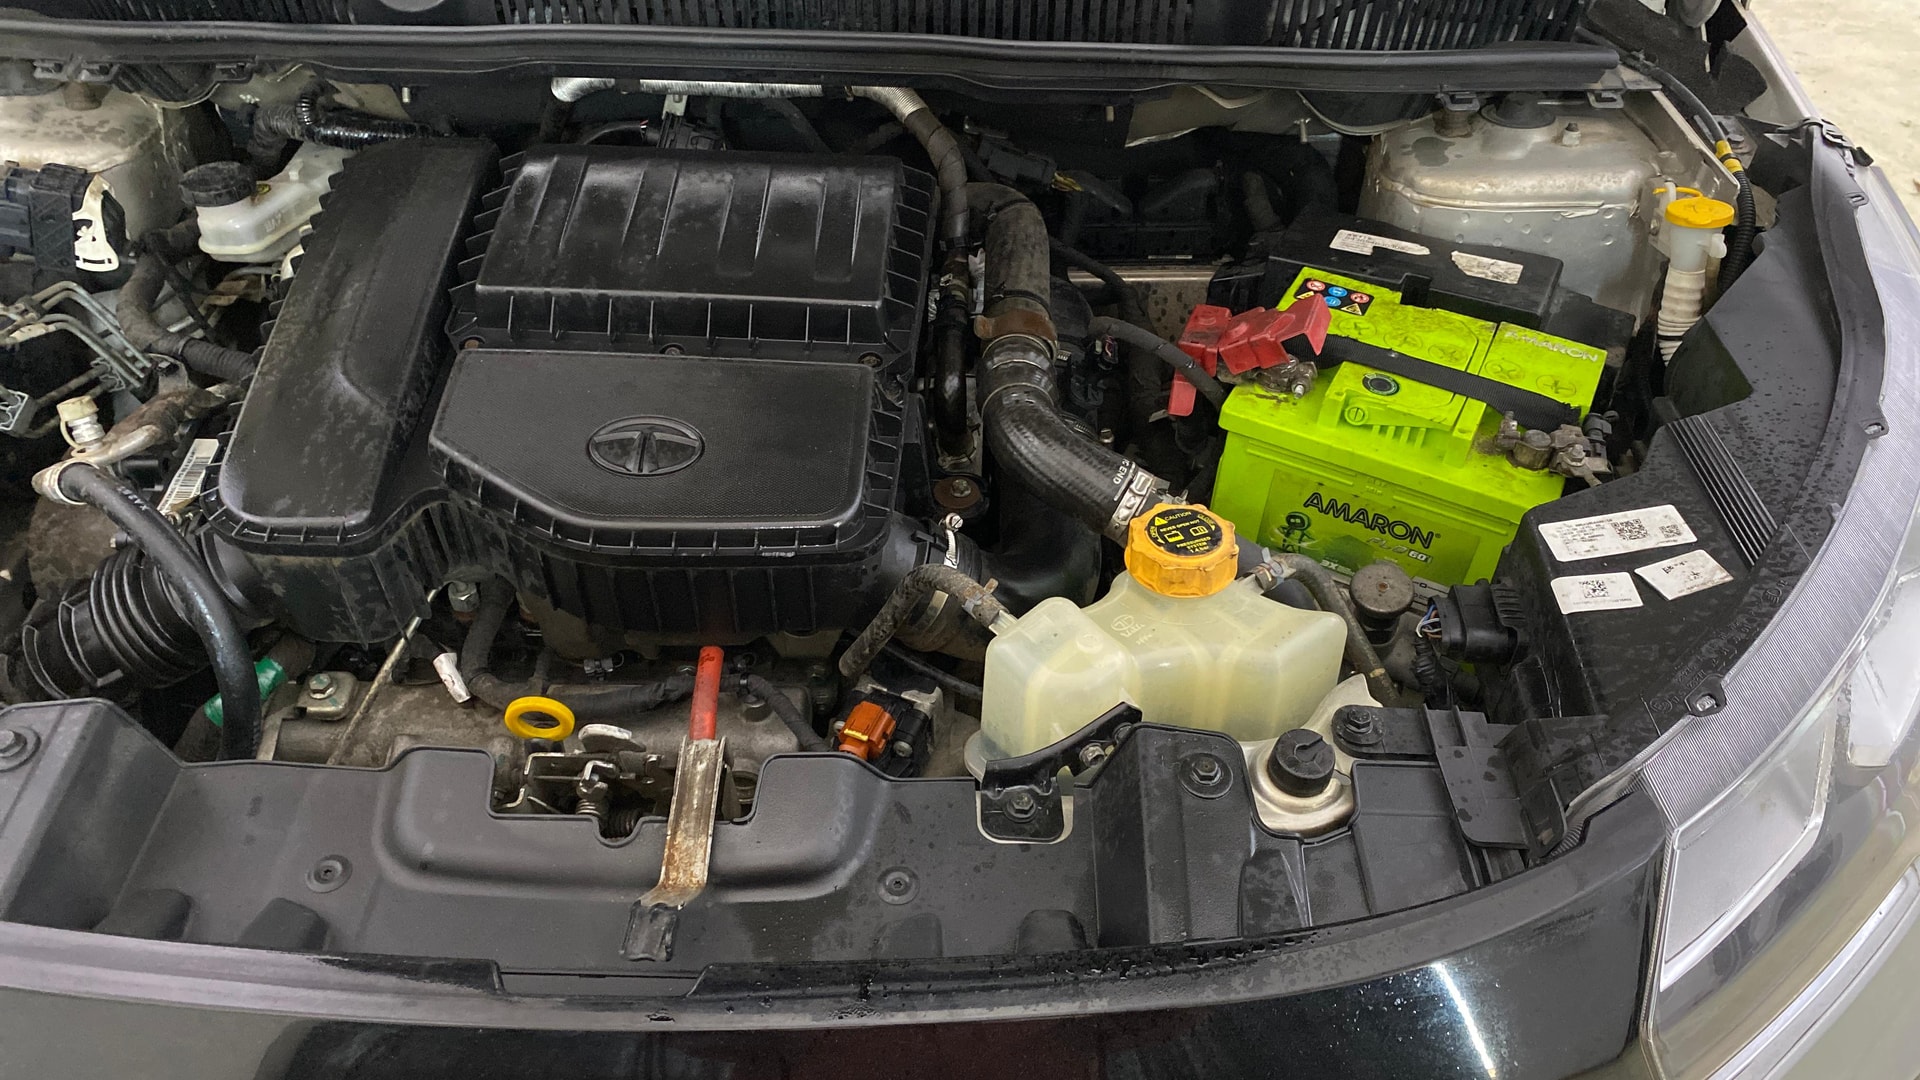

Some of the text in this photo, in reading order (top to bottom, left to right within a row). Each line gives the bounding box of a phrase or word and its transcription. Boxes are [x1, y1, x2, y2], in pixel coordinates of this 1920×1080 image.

[1504, 331, 1598, 362] AMARON
[1113, 466, 1127, 485] END
[1164, 511, 1192, 521] CAUTION
[1304, 492, 1434, 549] AMARON
